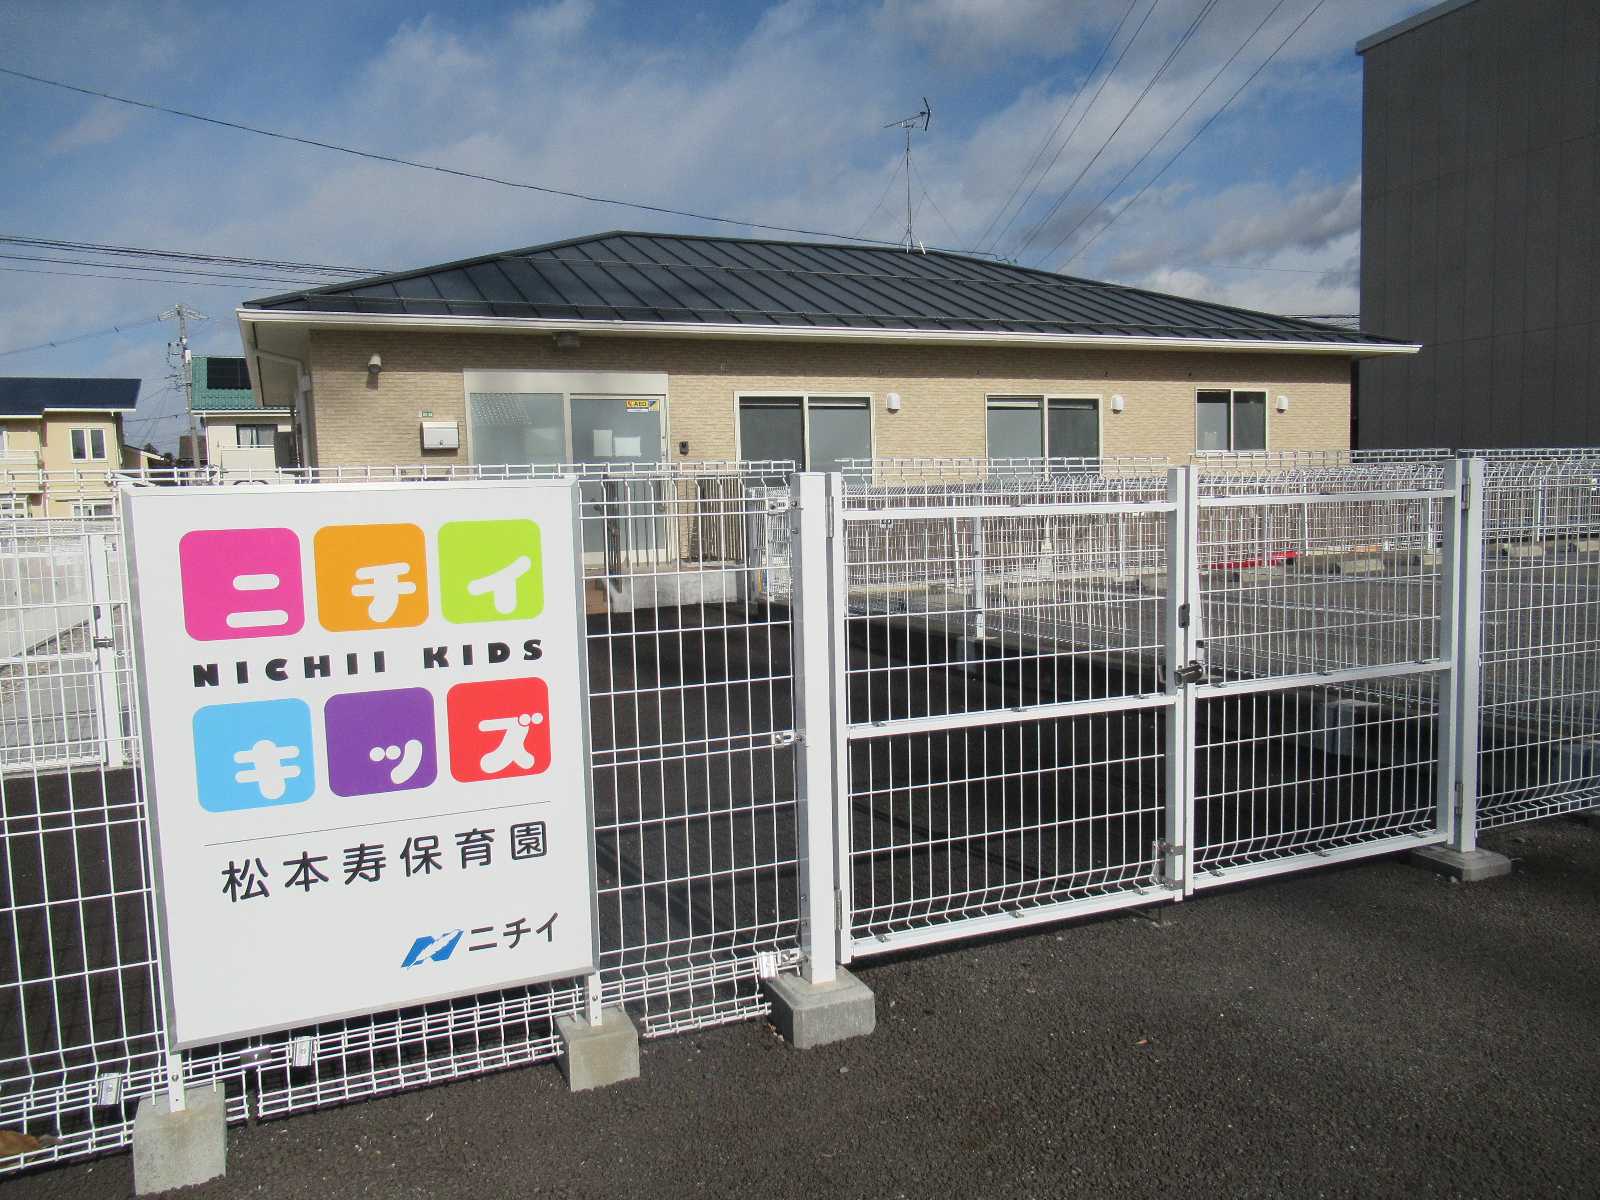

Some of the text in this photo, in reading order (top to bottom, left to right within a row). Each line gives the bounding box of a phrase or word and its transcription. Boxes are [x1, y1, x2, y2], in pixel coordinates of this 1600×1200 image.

[226, 556, 532, 629] ニチイ
[193, 639, 543, 688] NICHII KIDS
[234, 712, 544, 800] キッズ
[221, 820, 548, 903] 松本寿保育園
[468, 912, 559, 952] ニチイ
